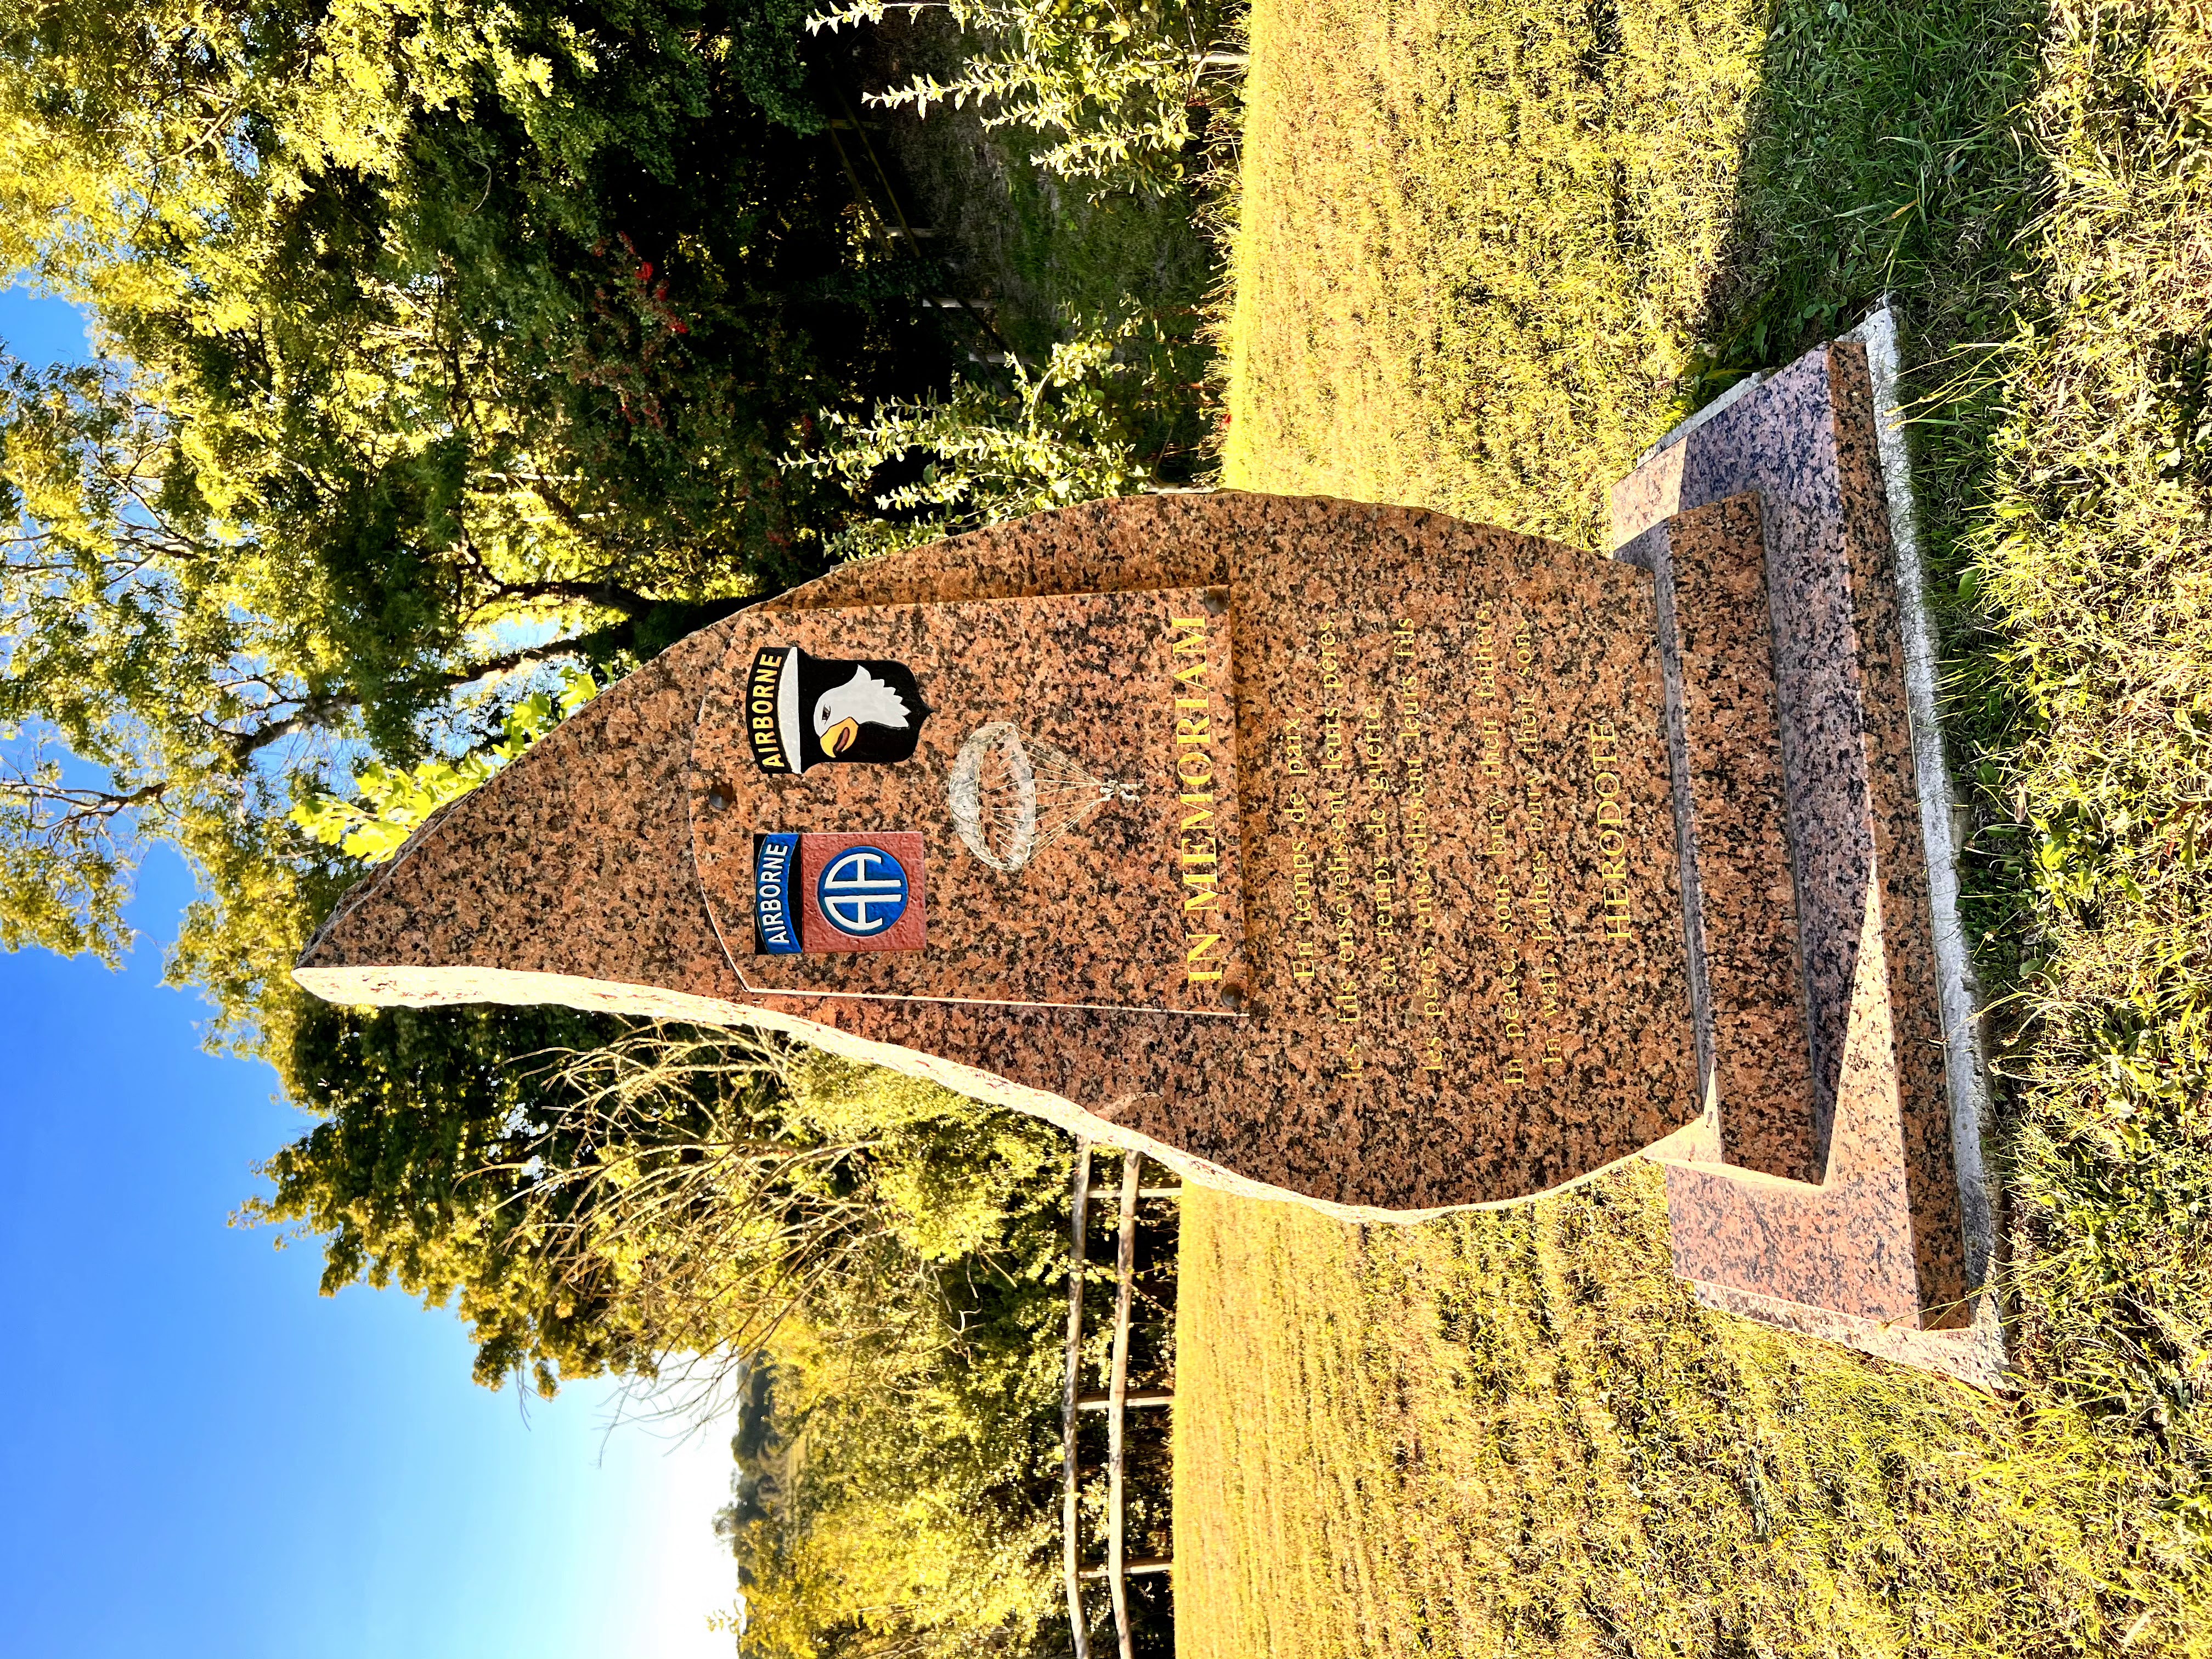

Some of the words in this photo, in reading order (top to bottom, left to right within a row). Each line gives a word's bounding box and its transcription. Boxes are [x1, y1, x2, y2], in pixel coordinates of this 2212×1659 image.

[1316, 612, 1344, 688] pères,
[1393, 618, 1415, 658] fils
[1473, 601, 1496, 698] fathers,
[1514, 619, 1533, 676] sons
[752, 654, 783, 767] AIRBORNE
[1400, 676, 1420, 738] leurs
[1516, 694, 1538, 753] their
[1171, 614, 1220, 911] MEMORIAM
[1279, 707, 1308, 775] paix,
[1322, 707, 1344, 770] leurs
[1363, 697, 1389, 792] guerre,
[1480, 716, 1501, 776] their
[1284, 792, 1306, 822] de
[1366, 809, 1387, 838] de
[1487, 794, 1508, 855] bury
[1524, 772, 1547, 831] bury
[1590, 721, 1632, 941] HERODOTE
[1403, 756, 1434, 928] ensevelissent
[759, 844, 789, 945] AIRBORNE
[824, 853, 902, 930] AA
[1291, 841, 1313, 921] temps
[1327, 788, 1355, 962] ensevelissent
[1372, 856, 1395, 936] temps
[1493, 874, 1514, 933] sons
[1531, 851, 1553, 941] fathers
[1184, 932, 1223, 984] IN
[1293, 941, 1315, 979] En
[1378, 956, 1397, 986] en
[1417, 946, 1444, 1016] pères
[1539, 957, 1559, 1017] war,
[1337, 980, 1358, 1022] fils
[1500, 947, 1526, 1038] peace,
[1341, 1043, 1362, 1079] les
[1423, 1036, 1443, 1071] les
[1504, 1058, 1524, 1085] In
[1541, 1037, 1562, 1064] In
